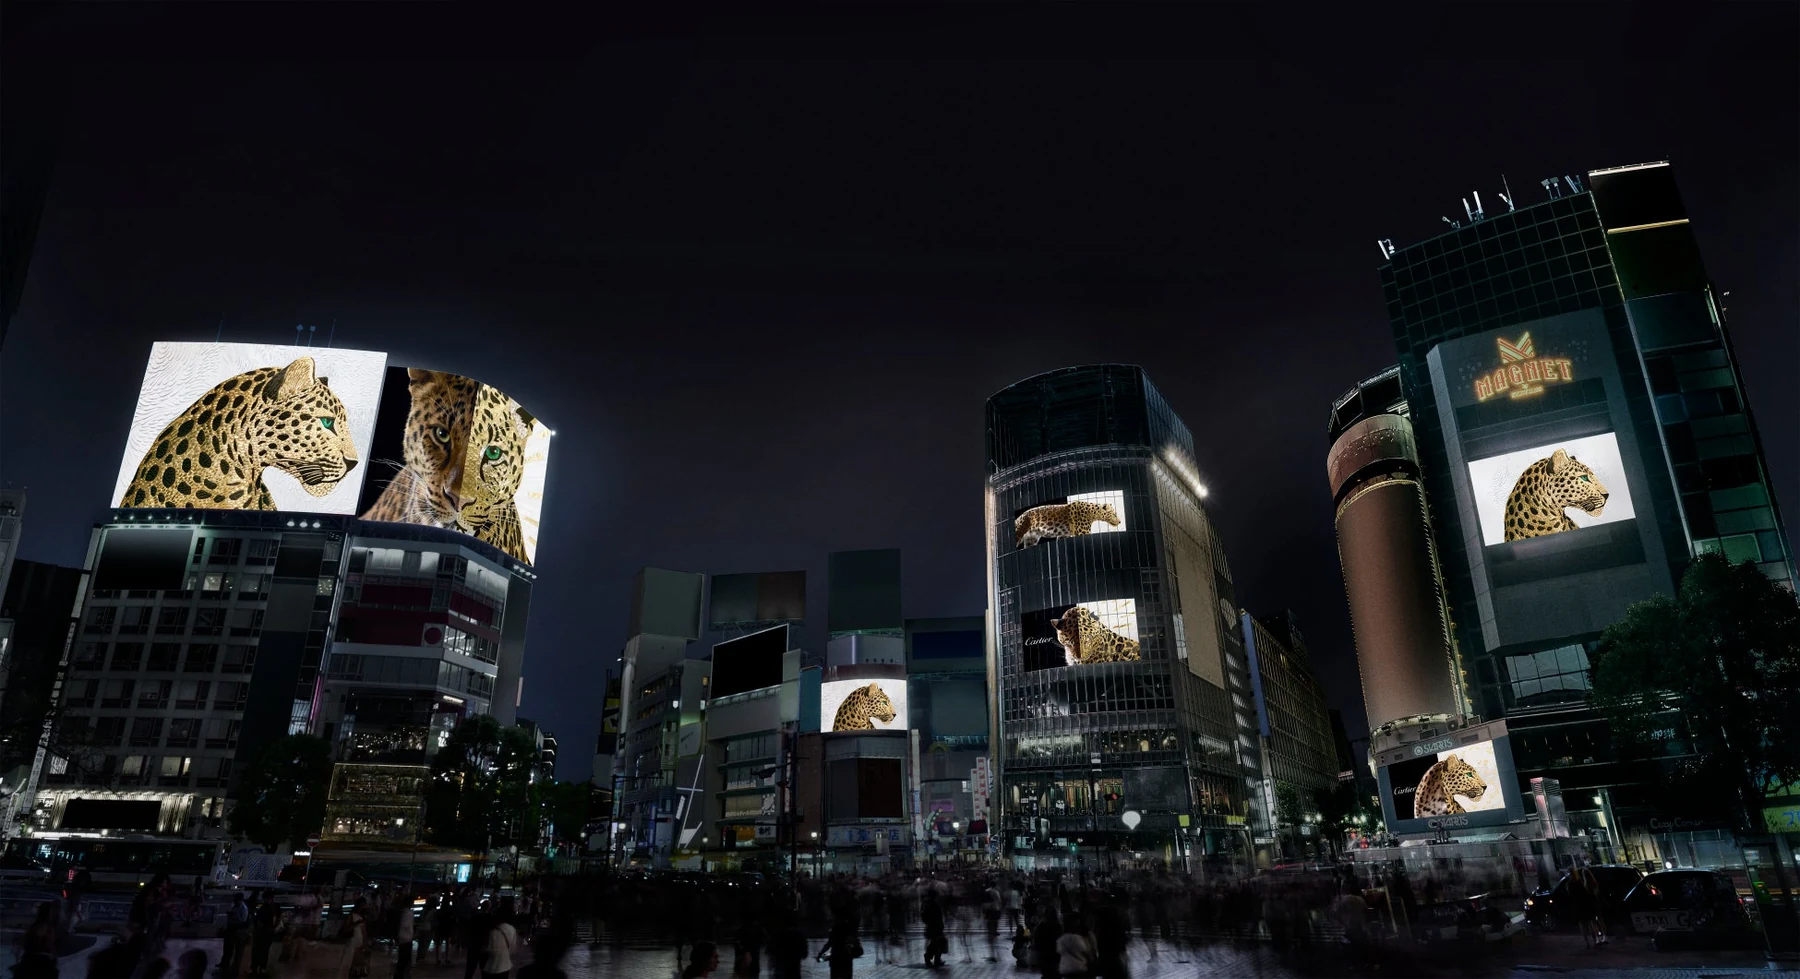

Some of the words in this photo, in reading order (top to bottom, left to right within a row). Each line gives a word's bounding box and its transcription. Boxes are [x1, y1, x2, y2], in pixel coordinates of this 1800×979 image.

[1474, 359, 1574, 402] MAGNET
[1024, 636, 1053, 646] Cartier
[1393, 786, 1416, 796] Cartier
[1024, 806, 1106, 816] SARBUCKS
